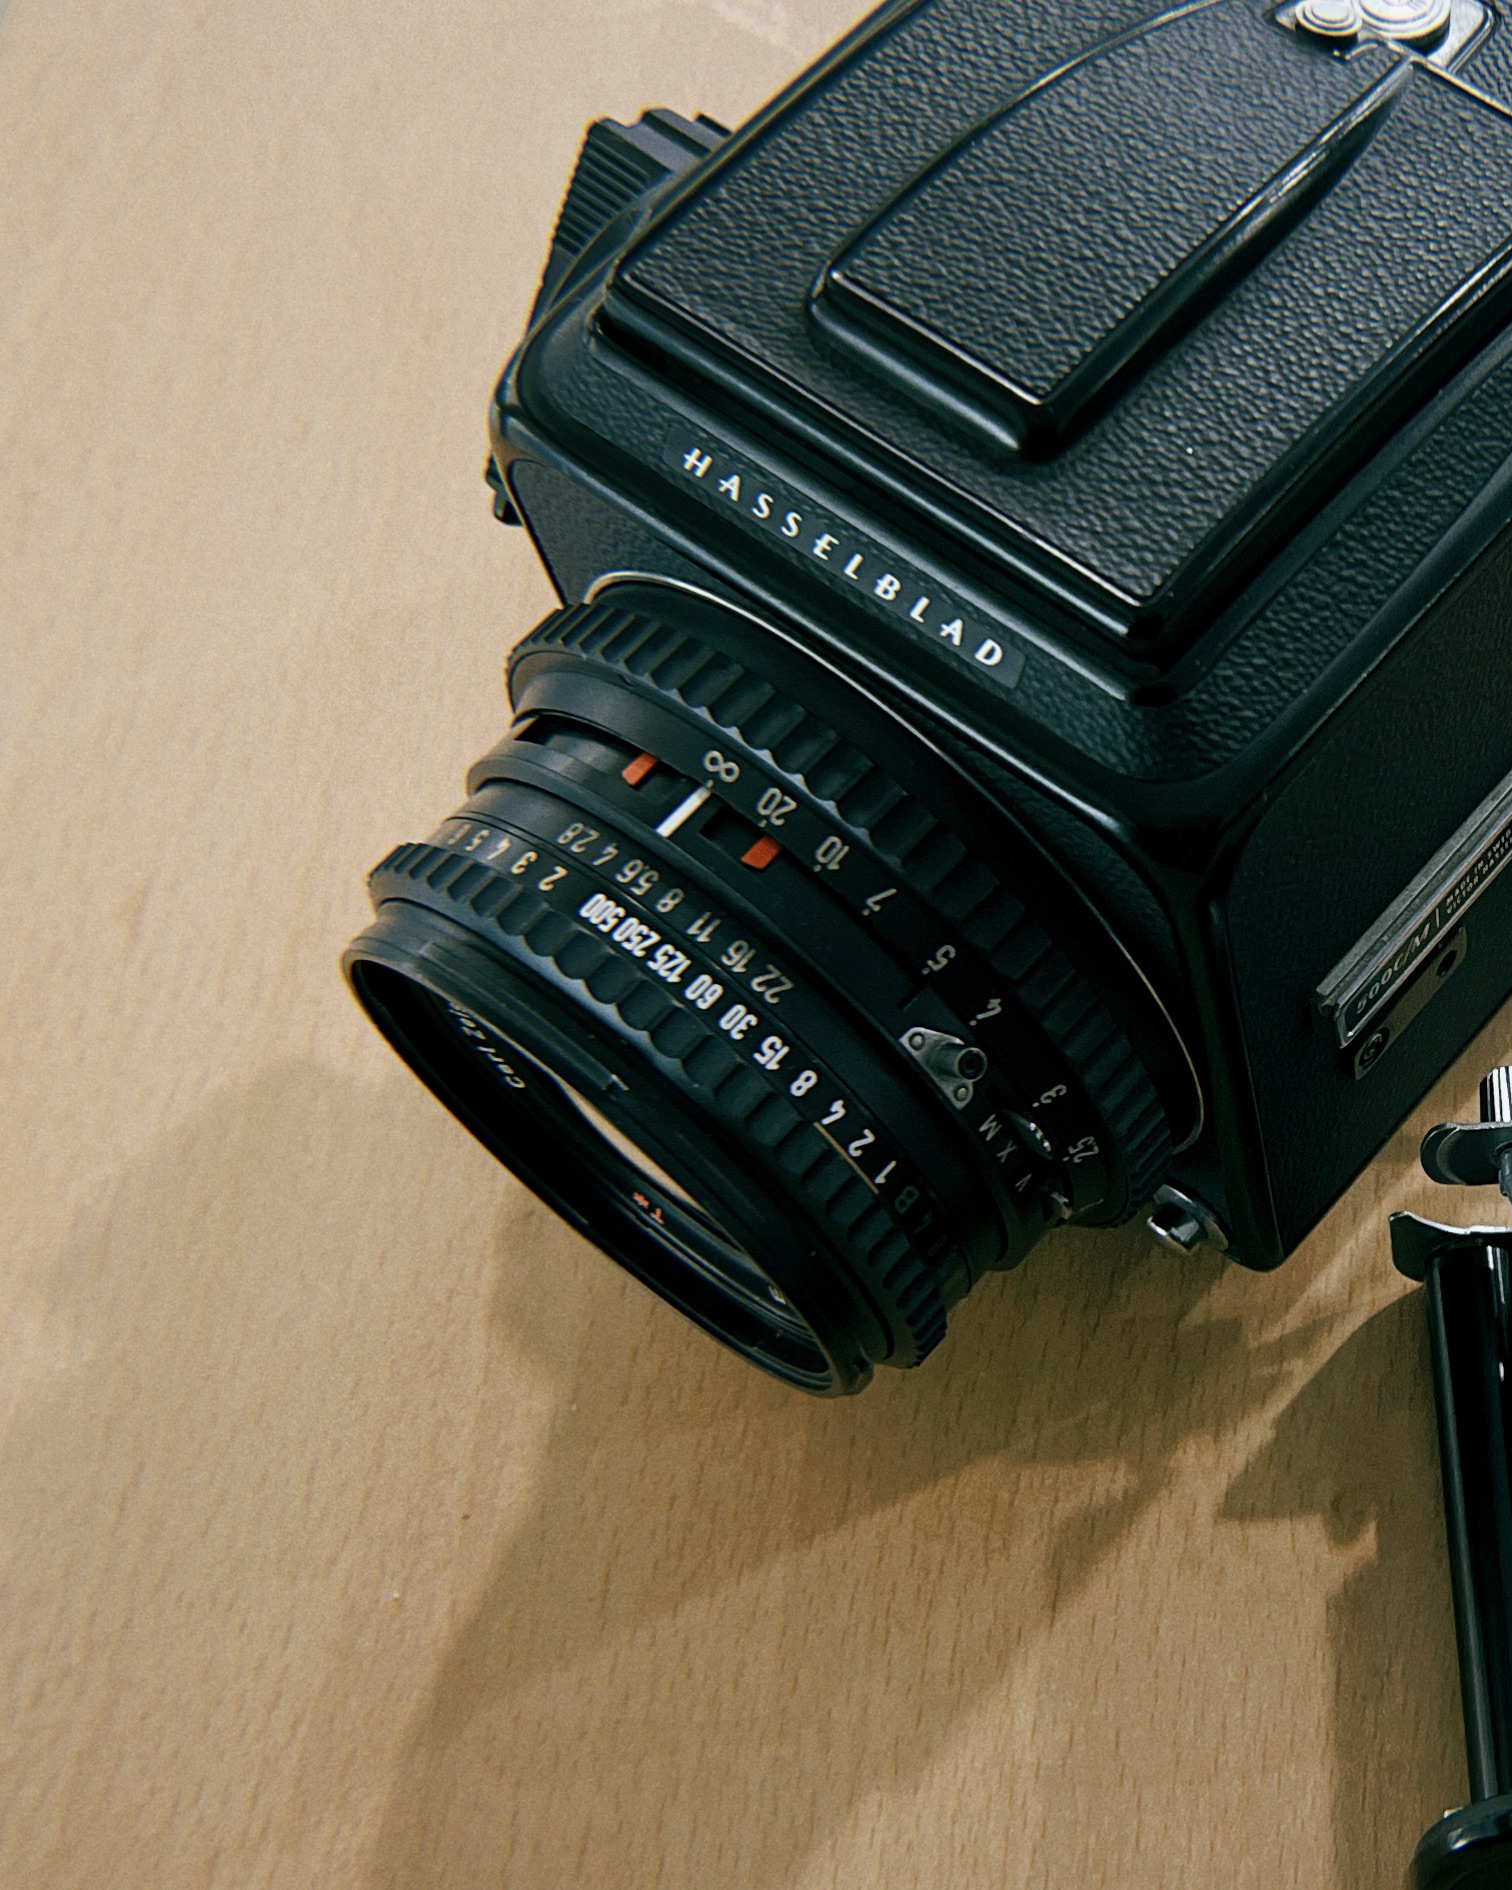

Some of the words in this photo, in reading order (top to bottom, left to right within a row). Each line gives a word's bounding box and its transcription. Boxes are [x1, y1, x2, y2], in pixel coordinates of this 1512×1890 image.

[681, 446, 1003, 666] HASSELBLAD
[757, 787, 798, 827] 20
[486, 838, 511, 861] 4
[510, 851, 538, 875] 3
[593, 842, 619, 866] 4
[815, 835, 850, 871] 10
[538, 865, 569, 892] 2
[579, 893, 626, 933] 500
[656, 888, 685, 913] 8
[866, 888, 898, 912] 7
[612, 917, 661, 958] 250
[686, 912, 721, 943] 11
[647, 944, 691, 983] 125
[721, 940, 756, 973] 16
[927, 944, 957, 972] 5
[1356, 922, 1430, 1014] 500C/M
[684, 974, 724, 1010] 60
[751, 963, 794, 1004] 22
[718, 1004, 758, 1040] 30
[976, 998, 1002, 1020] 4
[753, 1035, 790, 1070] 15
[789, 1069, 818, 1097] 8
[1040, 1084, 1067, 1105] 3
[820, 1099, 847, 1126] 4
[979, 1113, 1003, 1142] M
[848, 1128, 876, 1158] 2
[997, 1140, 1018, 1164] X
[873, 1160, 897, 1184] 1
